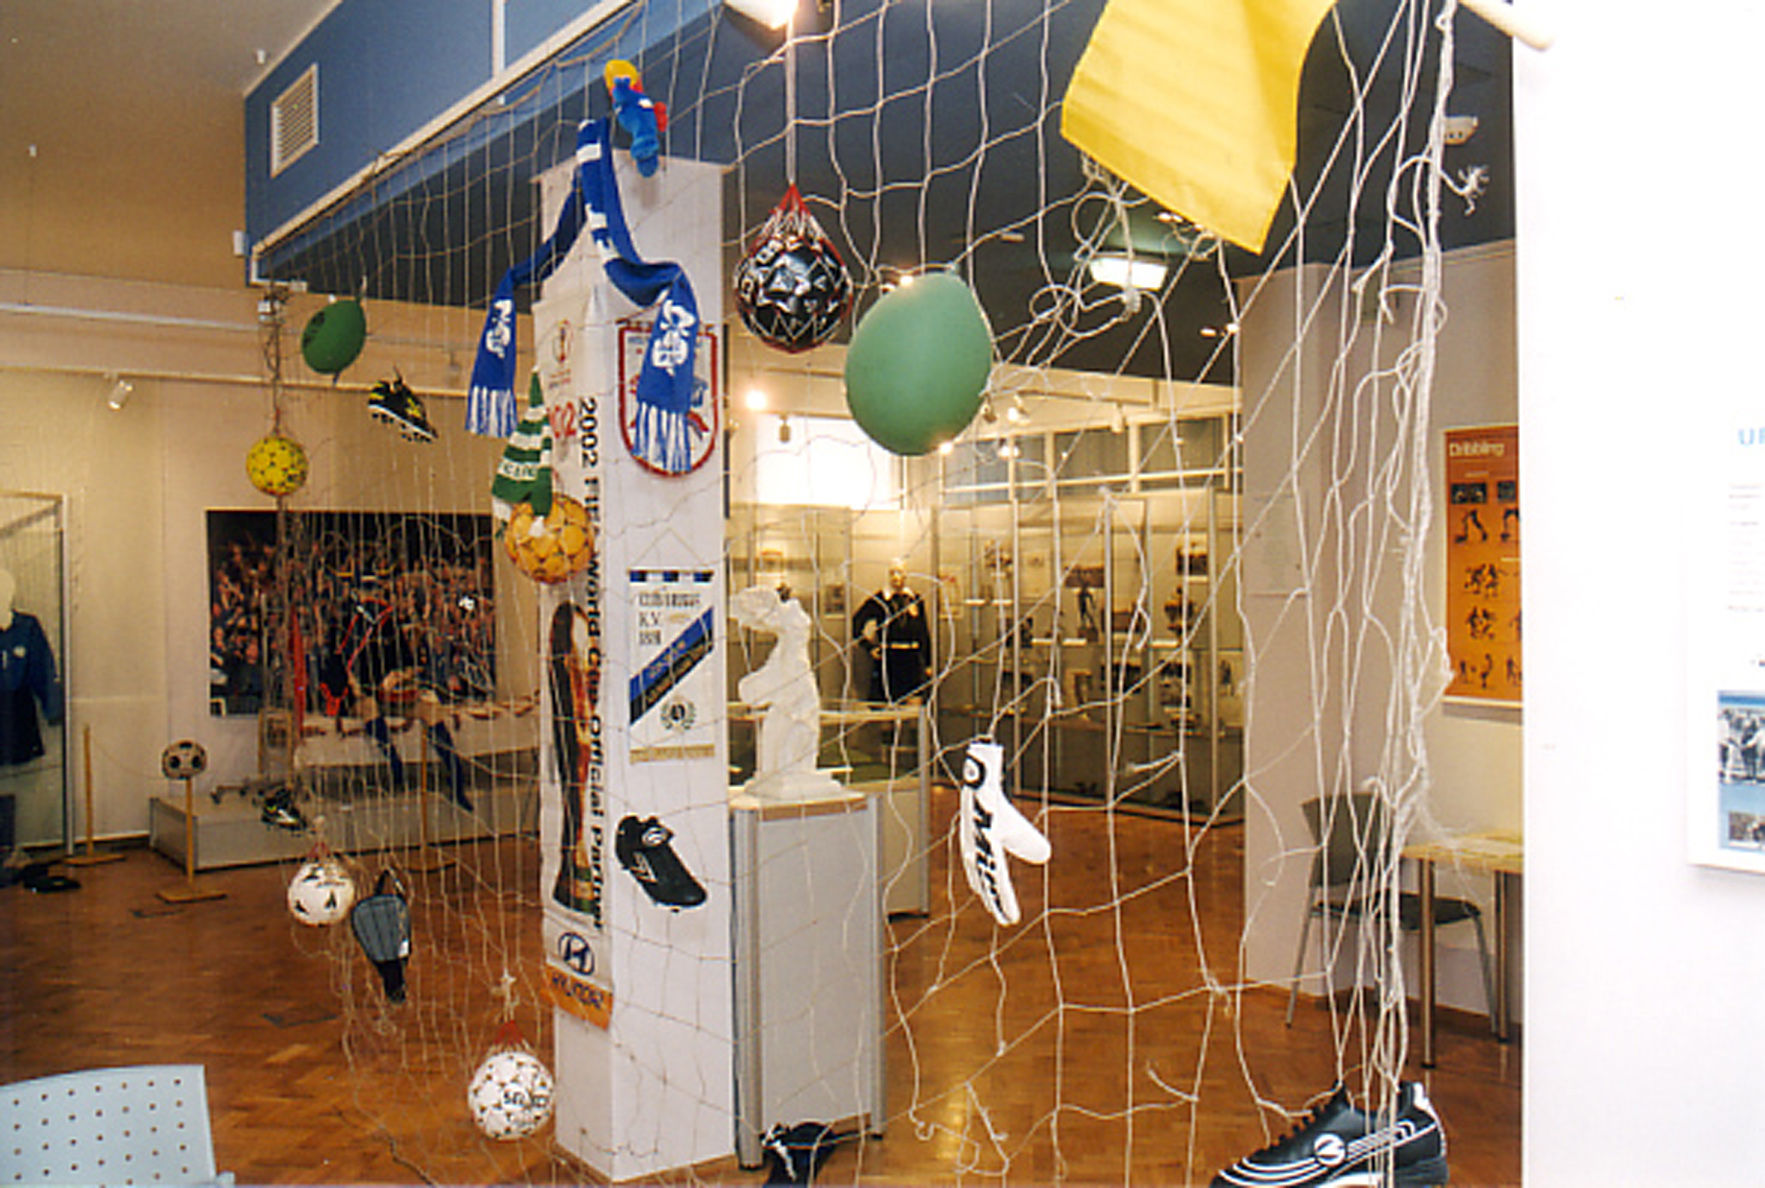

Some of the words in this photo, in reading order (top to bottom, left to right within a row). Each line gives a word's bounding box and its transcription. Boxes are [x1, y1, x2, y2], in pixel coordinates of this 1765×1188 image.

[580, 397, 598, 468] 2002
[1448, 441, 1505, 458] Dribbling
[586, 553, 601, 637] World
[590, 715, 605, 817] Official
